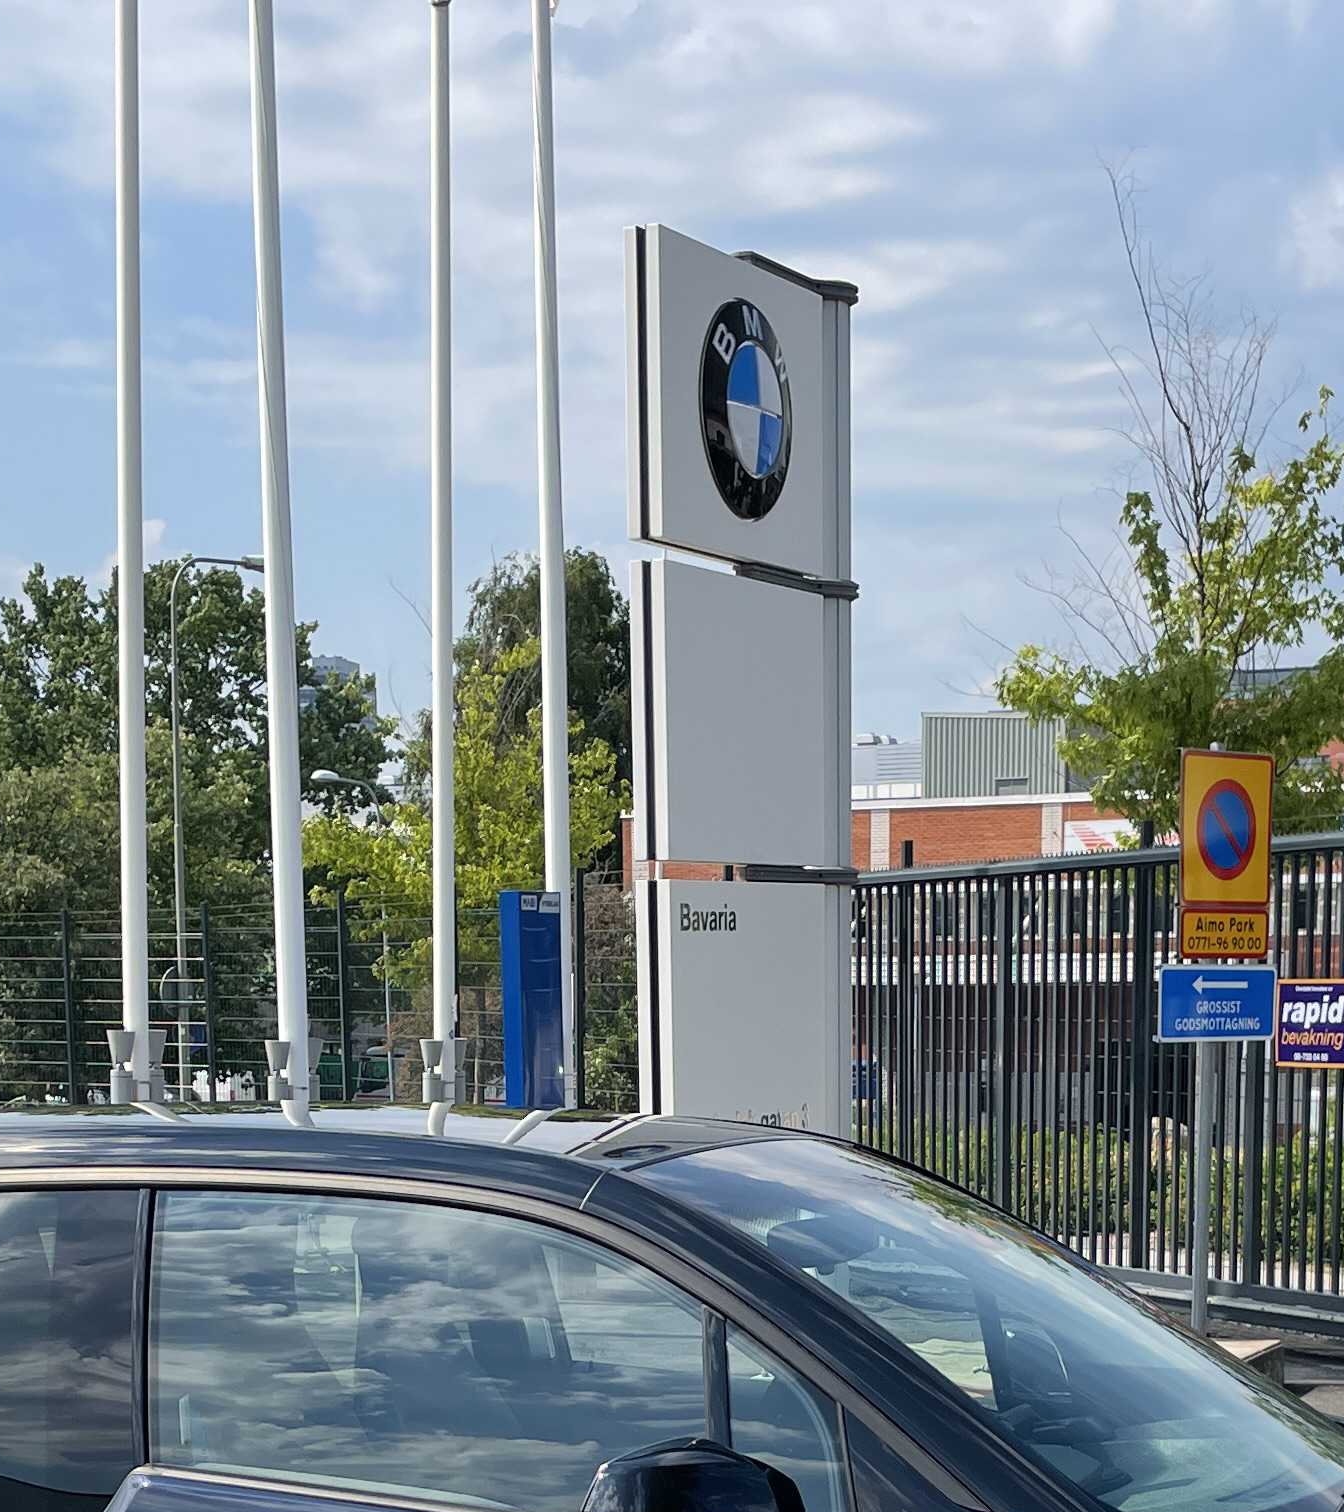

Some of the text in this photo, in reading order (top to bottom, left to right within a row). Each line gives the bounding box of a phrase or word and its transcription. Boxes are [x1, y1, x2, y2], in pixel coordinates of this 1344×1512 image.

[711, 304, 788, 384] BMW
[679, 902, 737, 931] Bavaria
[1195, 917, 1255, 932] Aimo Park
[1187, 936, 1262, 950] 0771-96 90 00
[1195, 1000, 1242, 1014] GROSSIST
[1174, 1017, 1261, 1031] GODSMOTTAGNING
[1281, 1027, 1344, 1051] bevakning
